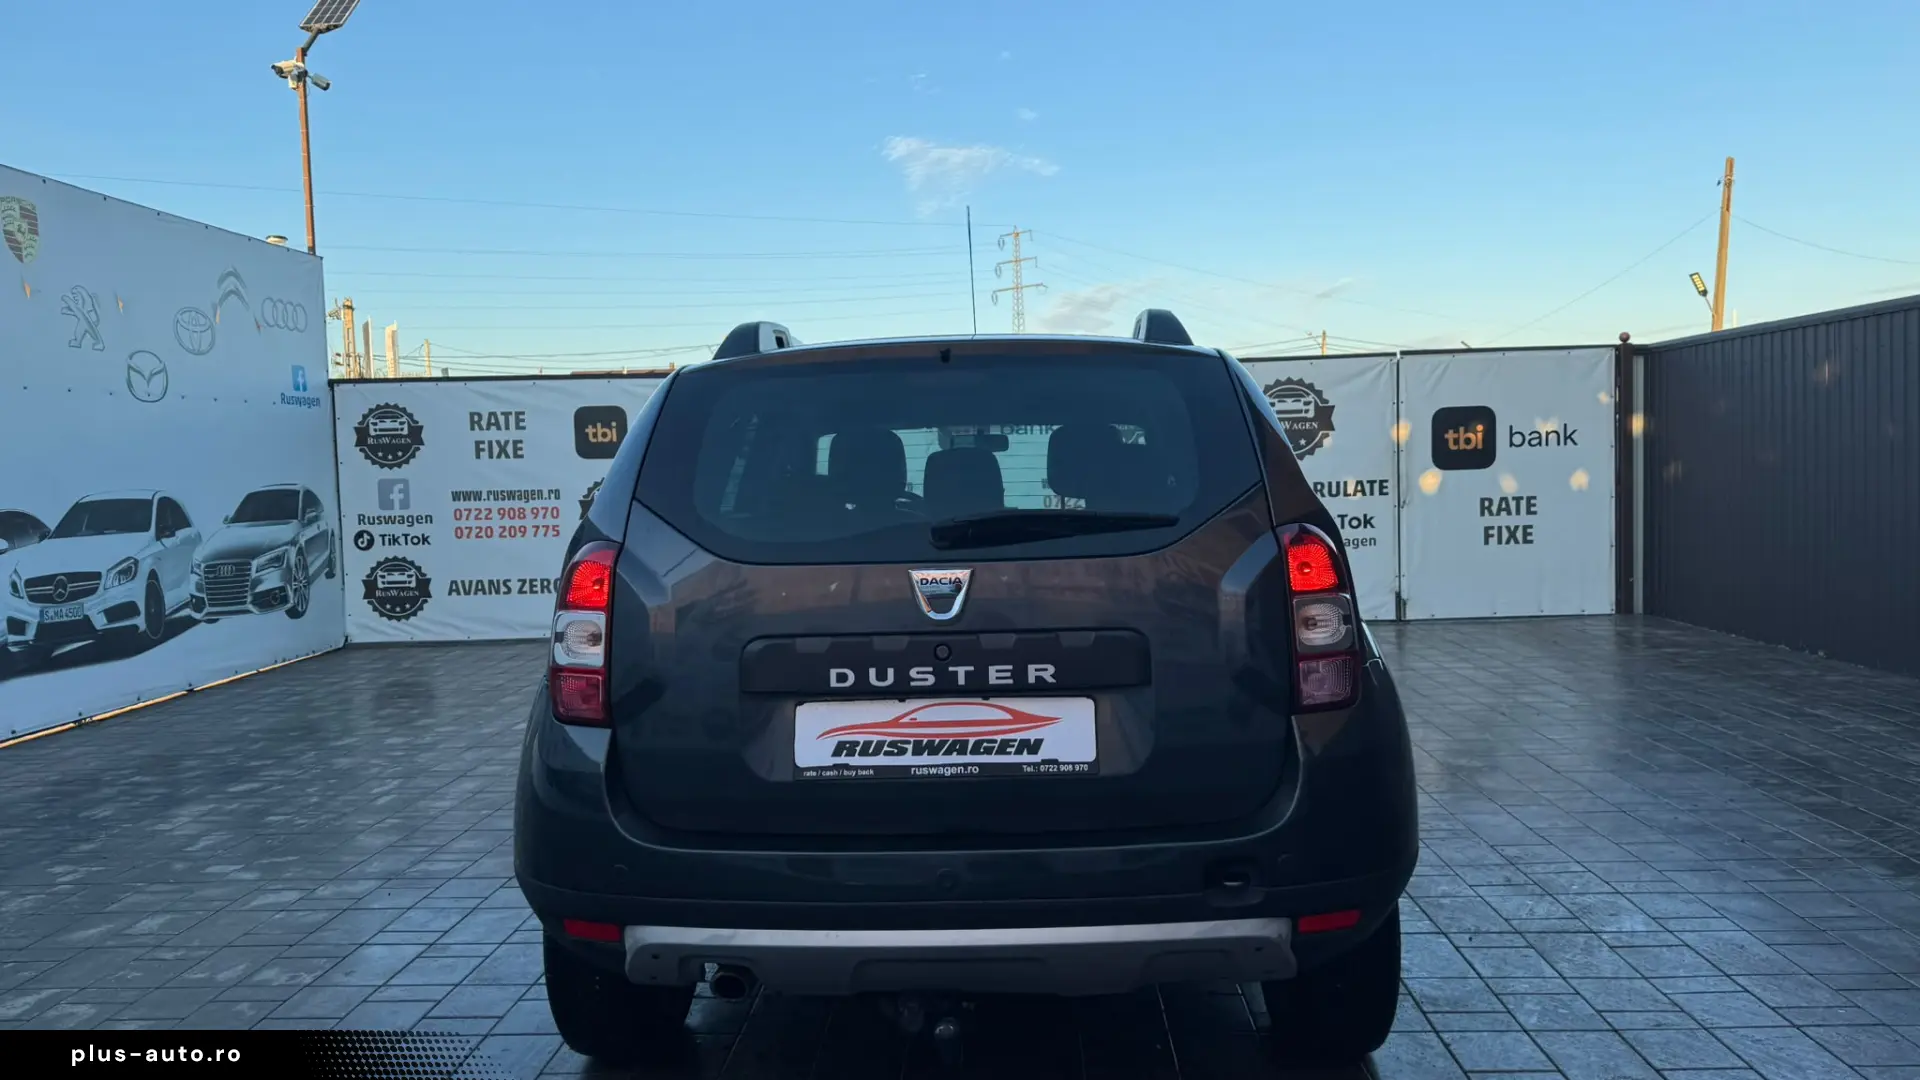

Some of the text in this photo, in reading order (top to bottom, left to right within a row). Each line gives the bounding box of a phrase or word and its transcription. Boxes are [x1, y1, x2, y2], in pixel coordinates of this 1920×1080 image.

[280, 392, 321, 409] Ruswagen
[469, 411, 527, 432] RATE
[584, 421, 618, 443] tbi
[1444, 423, 1578, 451] tbi bank
[474, 440, 525, 460] FIXE
[451, 488, 561, 503] www.ruswagen.ro
[1312, 479, 1390, 498] RULATE
[453, 506, 560, 521] 0722 908 970
[1479, 496, 1538, 517] RATE
[357, 513, 433, 527] Ruswagen
[1336, 513, 1376, 529] Tok
[379, 533, 431, 546] TikTok
[454, 524, 560, 539] 0720 209 775
[1483, 525, 1534, 546] FIXE
[447, 579, 512, 597] AVANS
[920, 576, 963, 586] DACIA
[829, 663, 1057, 688] DUSTER
[830, 737, 1044, 758] RUSWAGEN
[822, 769, 839, 777] cash
[843, 769, 856, 778] buy
[858, 768, 875, 776] back
[911, 764, 979, 776] ruswagen.ro
[1040, 764, 1058, 772] 0722
[1059, 764, 1073, 772] 908
[1074, 763, 1089, 771] 970
